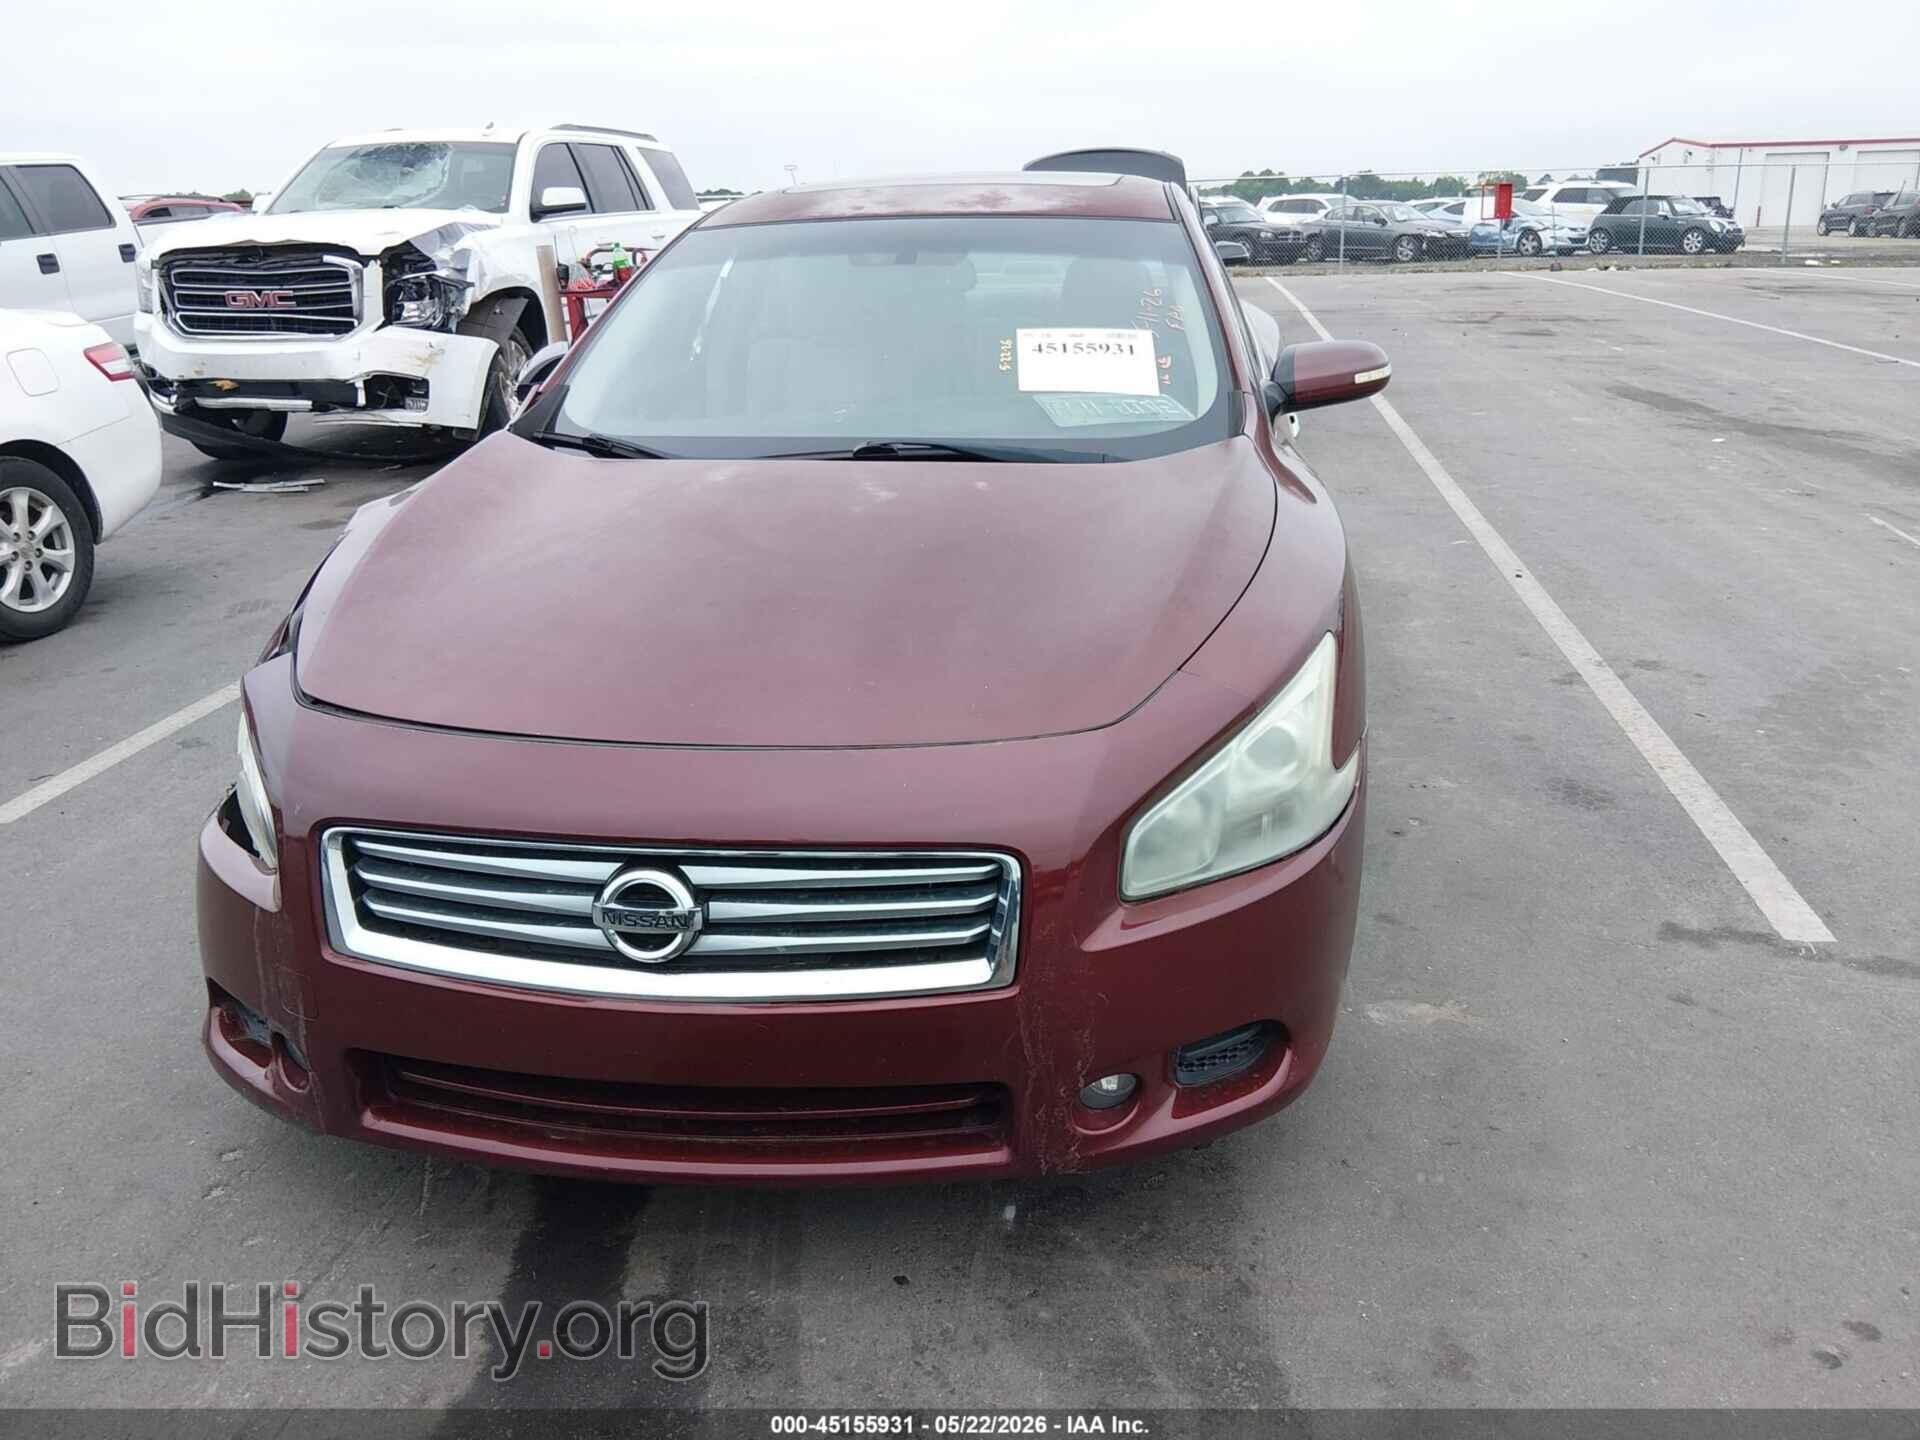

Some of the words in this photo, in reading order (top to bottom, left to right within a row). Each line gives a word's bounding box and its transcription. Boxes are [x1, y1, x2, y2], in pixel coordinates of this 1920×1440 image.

[224, 290, 297, 309] GMC
[1032, 342, 1134, 356] 45155931
[602, 911, 690, 929] NISSAN
